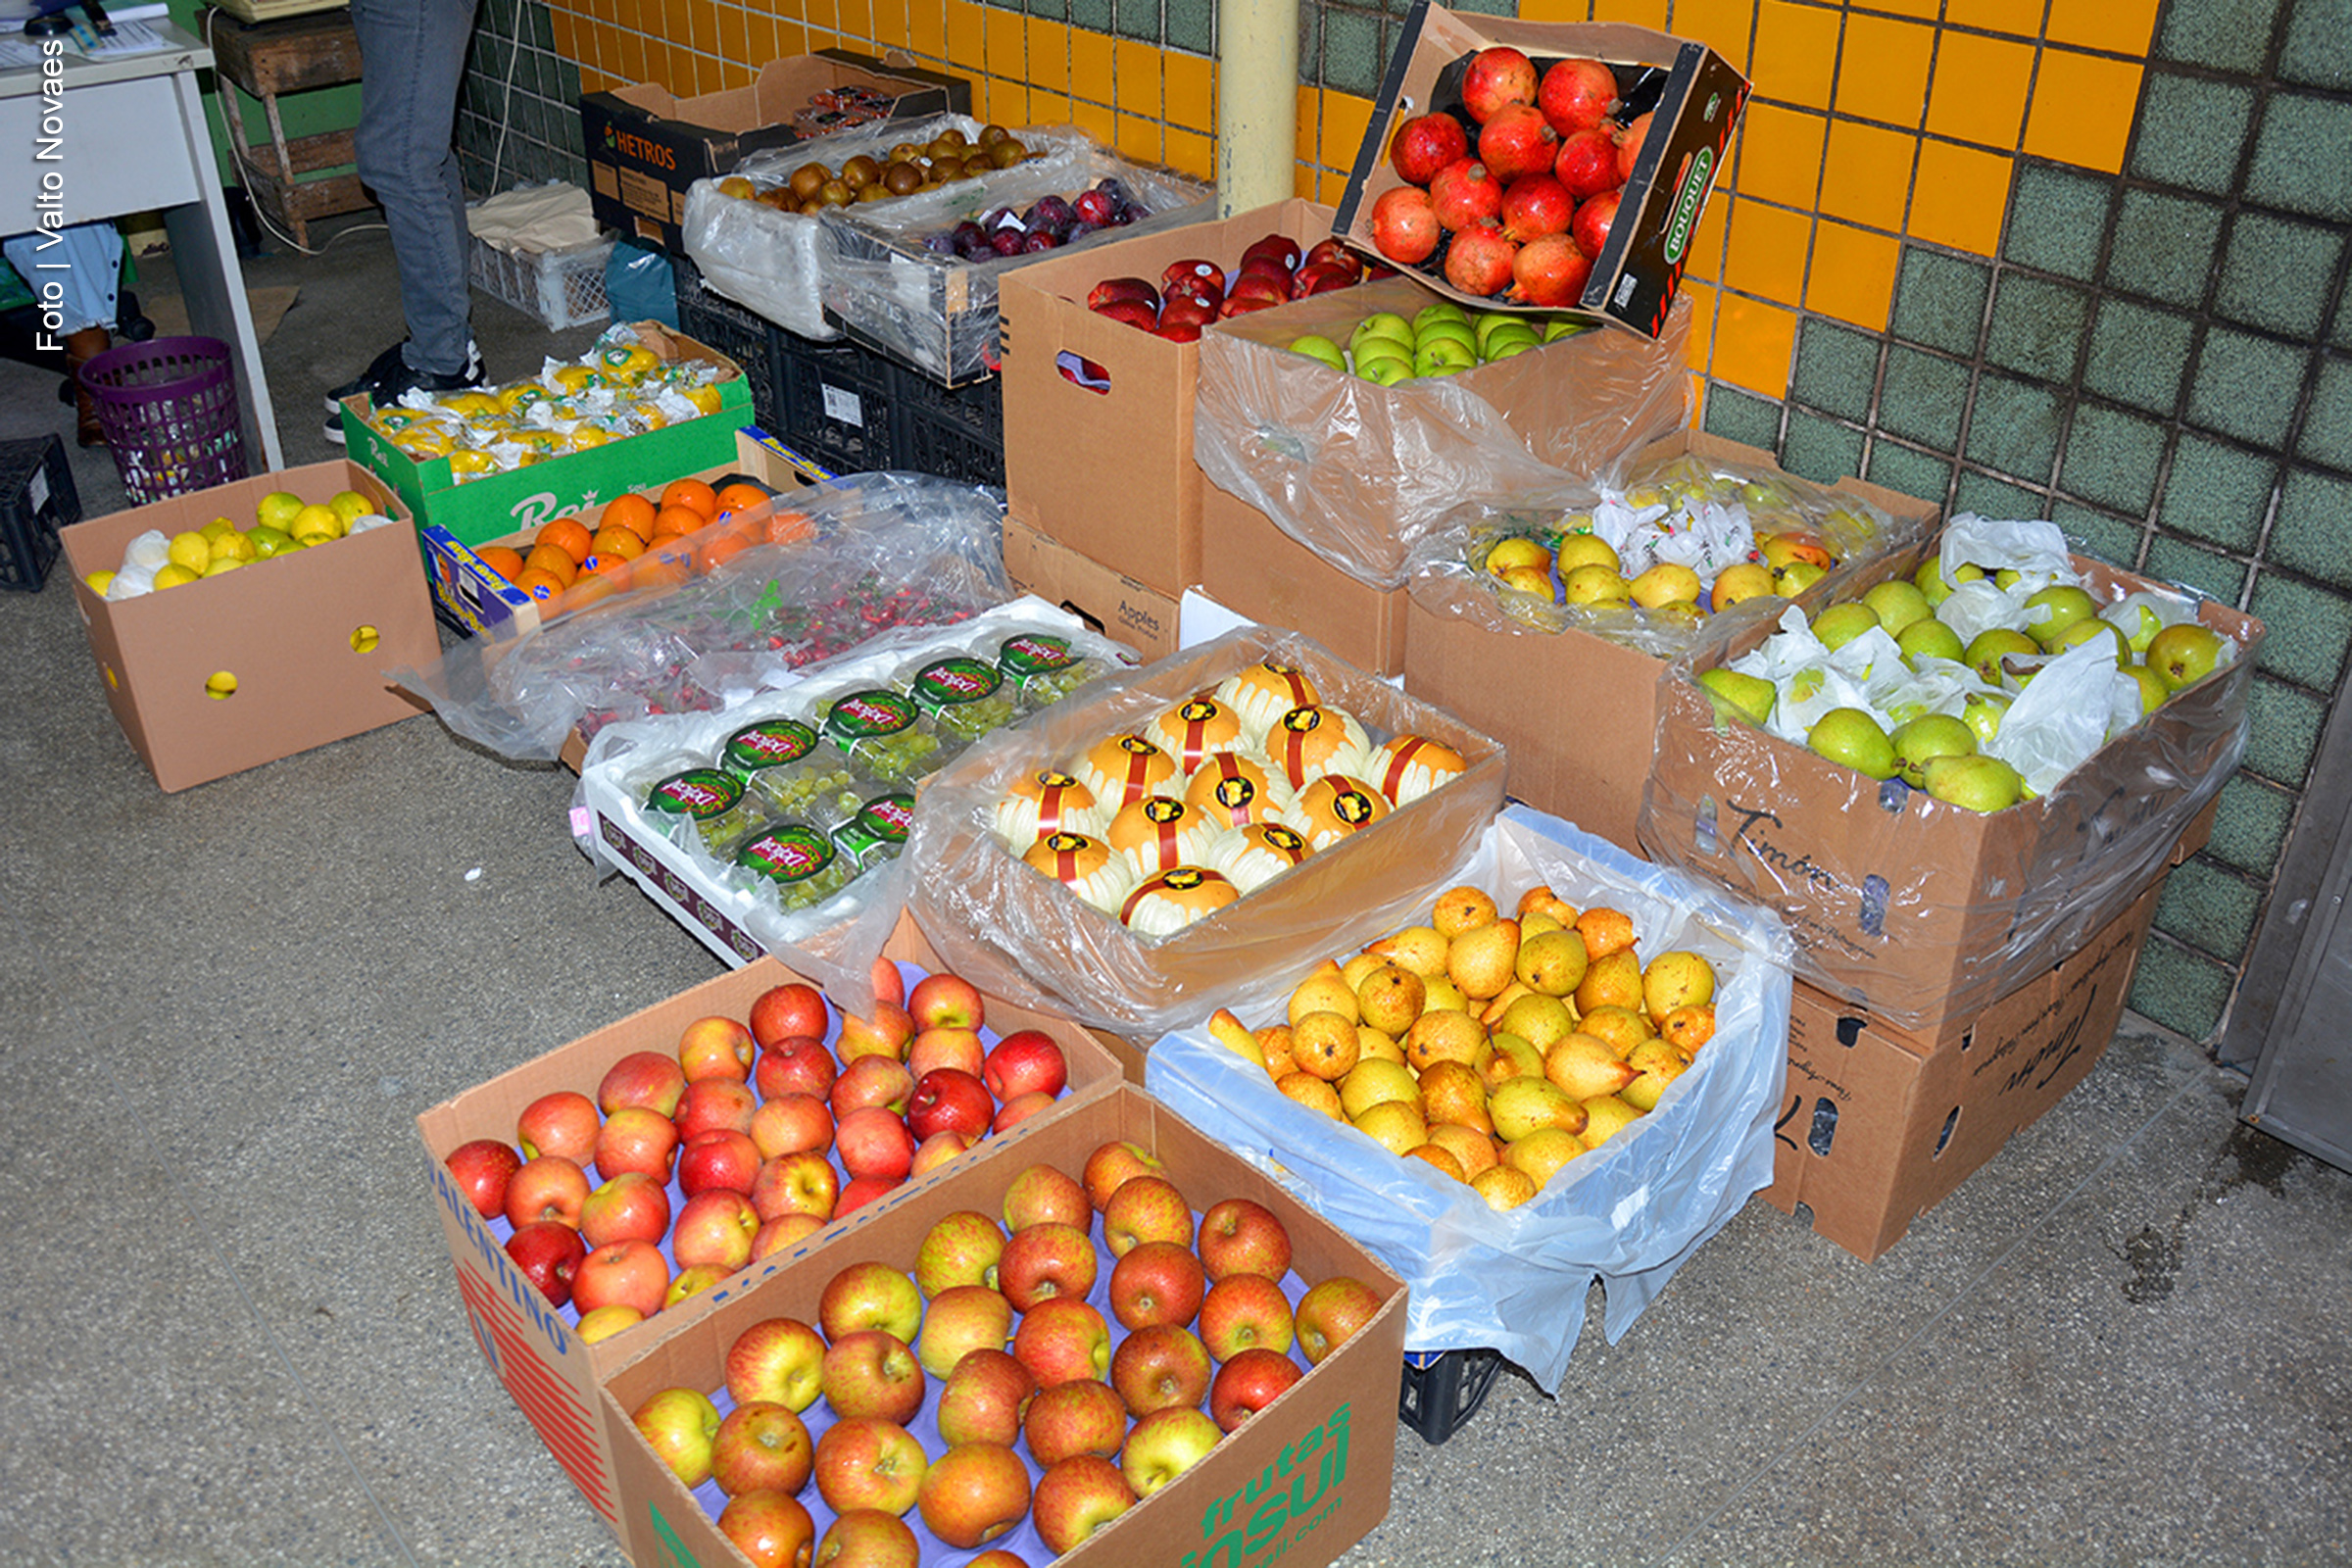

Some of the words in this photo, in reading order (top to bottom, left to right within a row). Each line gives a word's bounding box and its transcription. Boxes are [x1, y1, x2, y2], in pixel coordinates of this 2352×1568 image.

[615, 129, 676, 172] HETROS
[1669, 155, 1708, 254] BOUQUET
[1118, 600, 1159, 632] Apples
[1200, 1401, 1351, 1541] frutas
